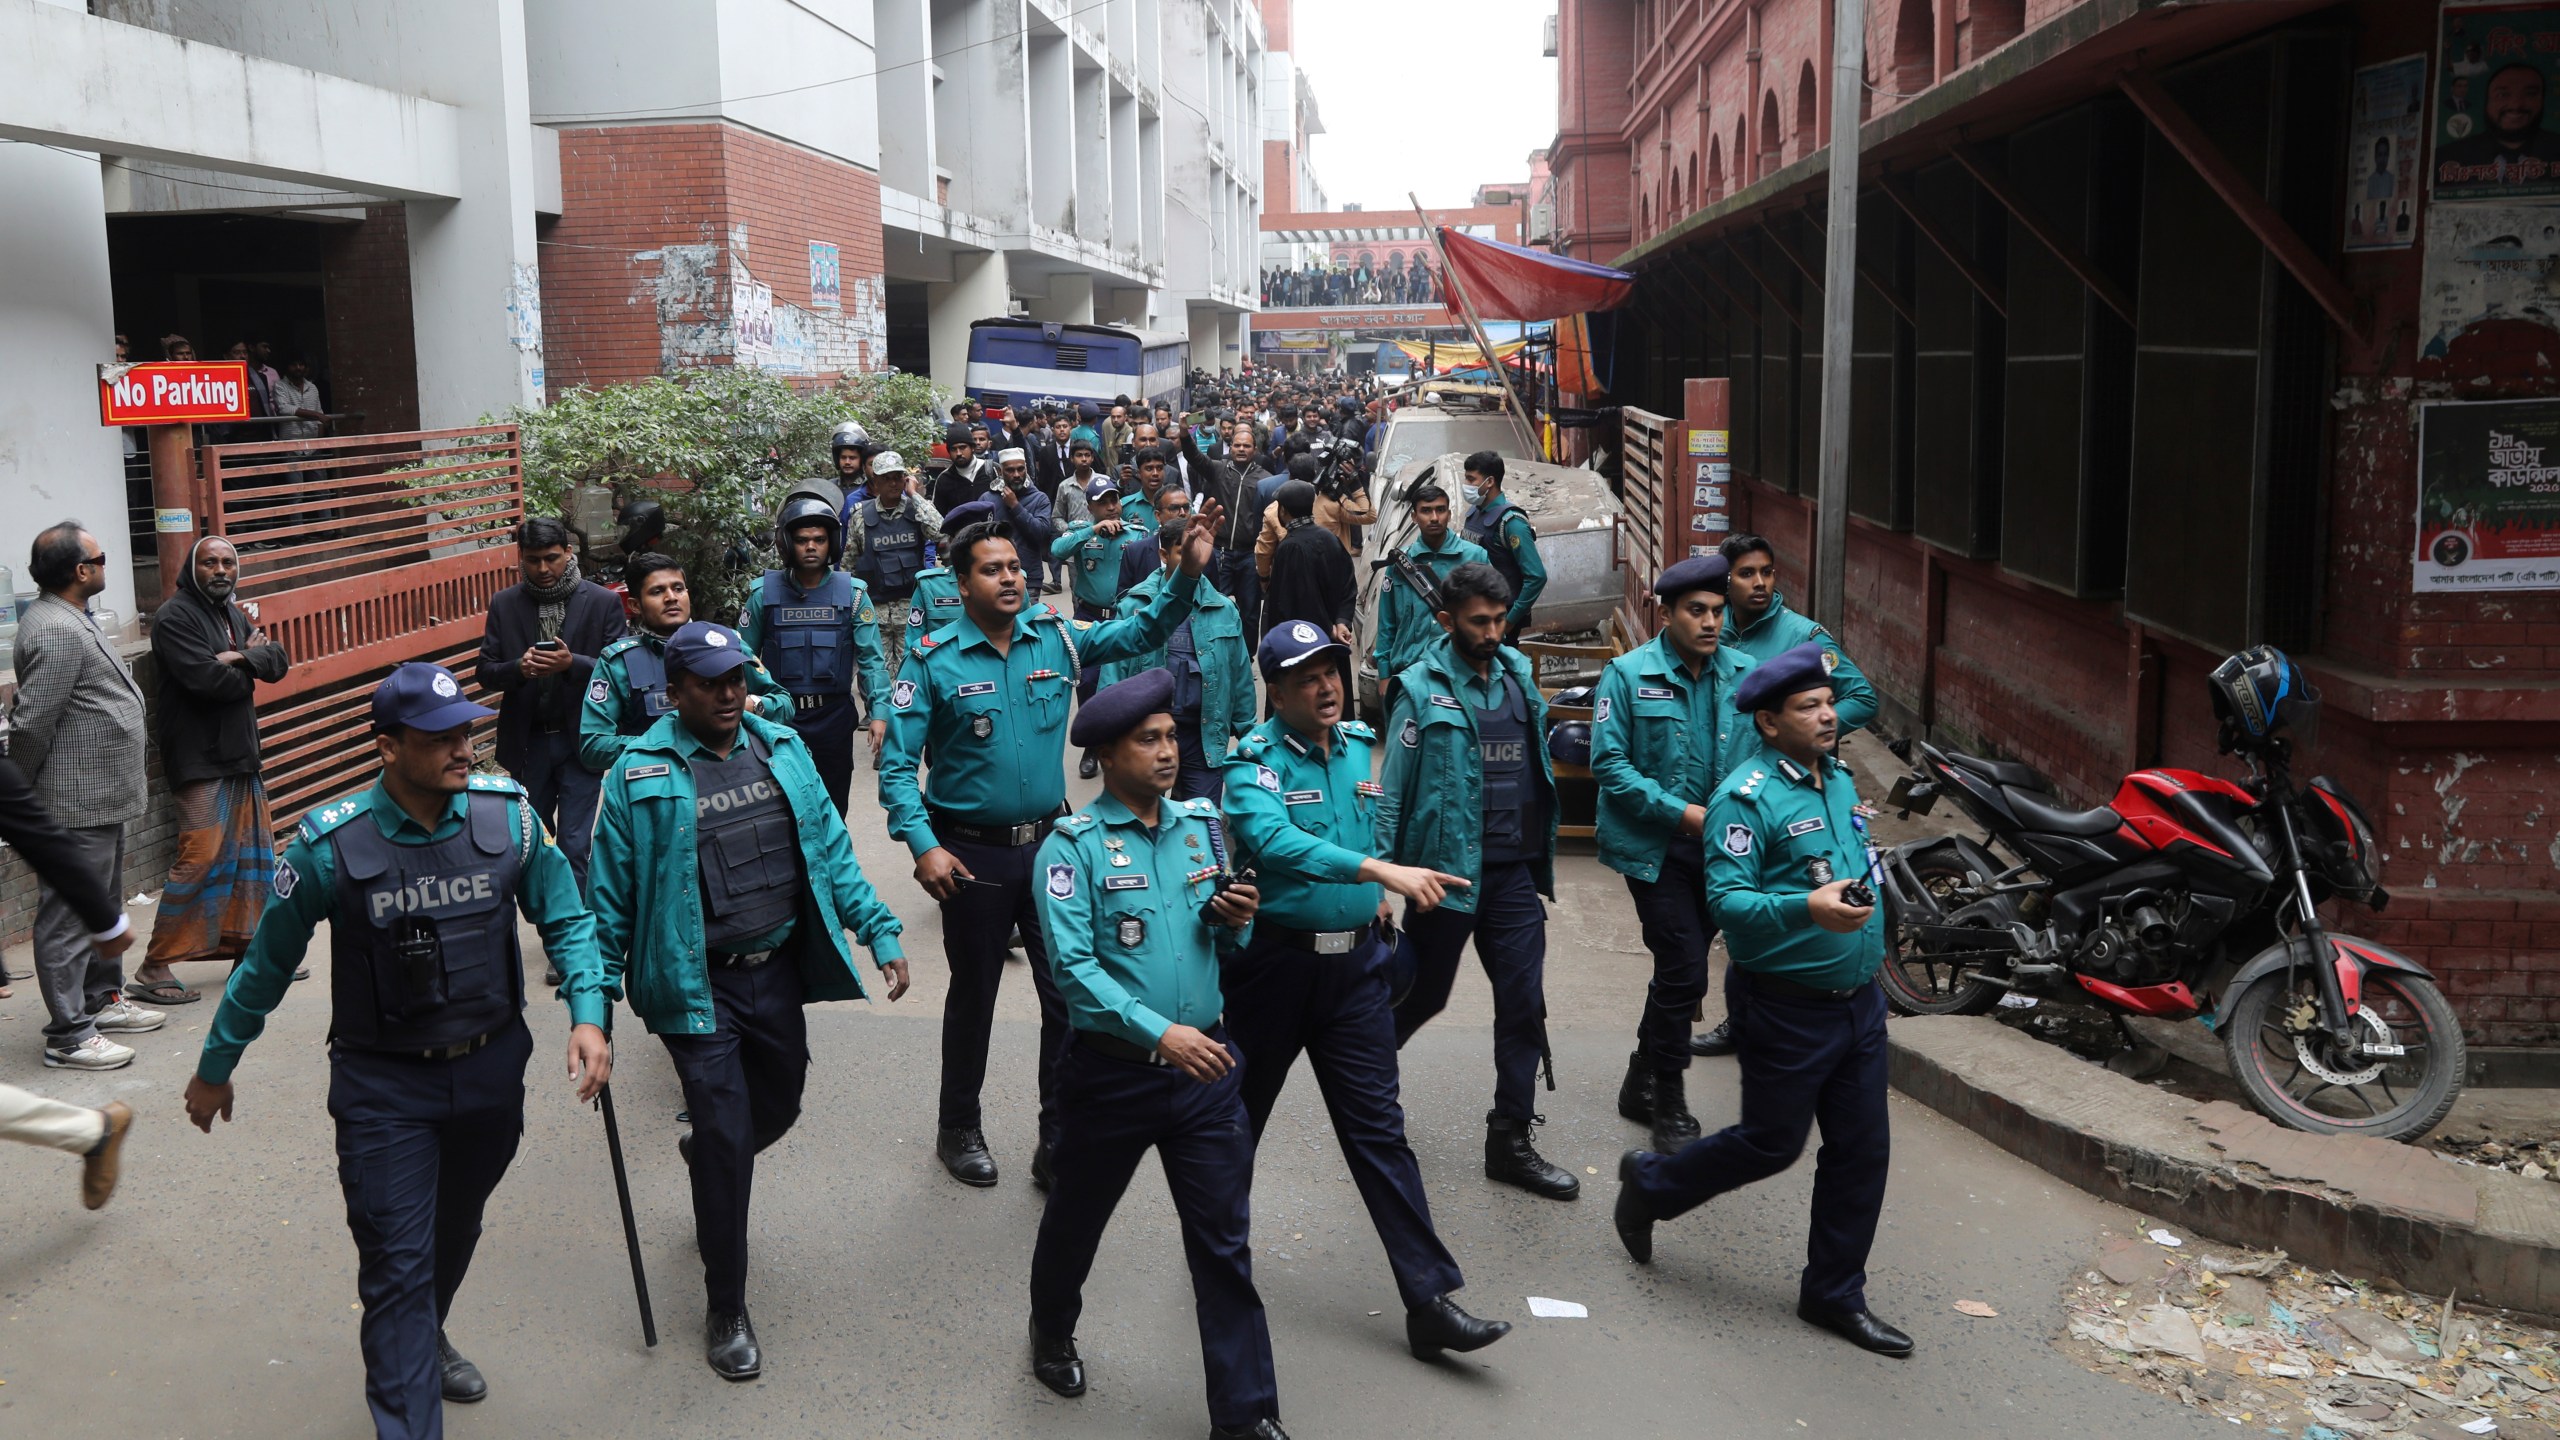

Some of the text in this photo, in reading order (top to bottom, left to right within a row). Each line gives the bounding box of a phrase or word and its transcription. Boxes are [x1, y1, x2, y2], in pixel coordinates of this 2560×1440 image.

[1320, 315, 1361, 326] আদালত
[114, 375, 239, 412] No Parking
[2489, 441, 2545, 468] জাতীয়
[2488, 464, 2560, 487] কাউন্সিল
[873, 532, 916, 547] POLICE
[2430, 574, 2454, 584] আমার
[2457, 572, 2495, 584] বাংলাদেশ
[2516, 571, 2536, 583] (এবি
[786, 609, 829, 619] POLICE
[697, 779, 783, 818] POLICE
[371, 874, 493, 918] POLICE
